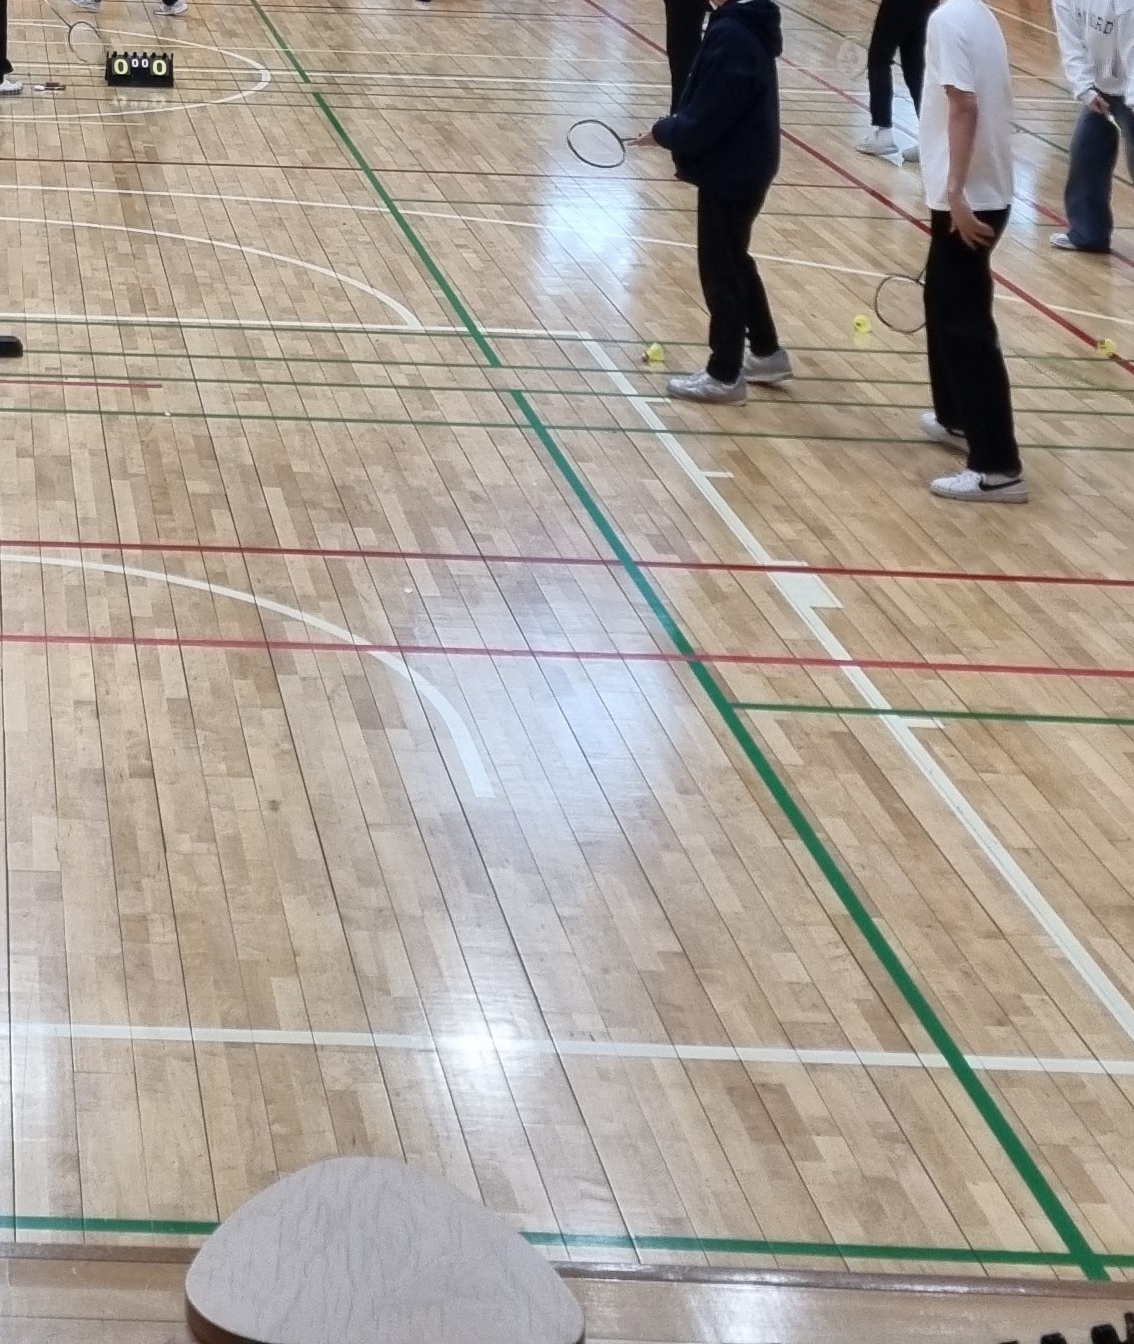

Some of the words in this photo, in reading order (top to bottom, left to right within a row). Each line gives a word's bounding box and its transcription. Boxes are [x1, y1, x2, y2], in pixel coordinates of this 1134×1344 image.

[114, 58, 128, 75] 0
[131, 58, 139, 68] 0
[141, 58, 149, 68] 0
[152, 59, 167, 76] 0
